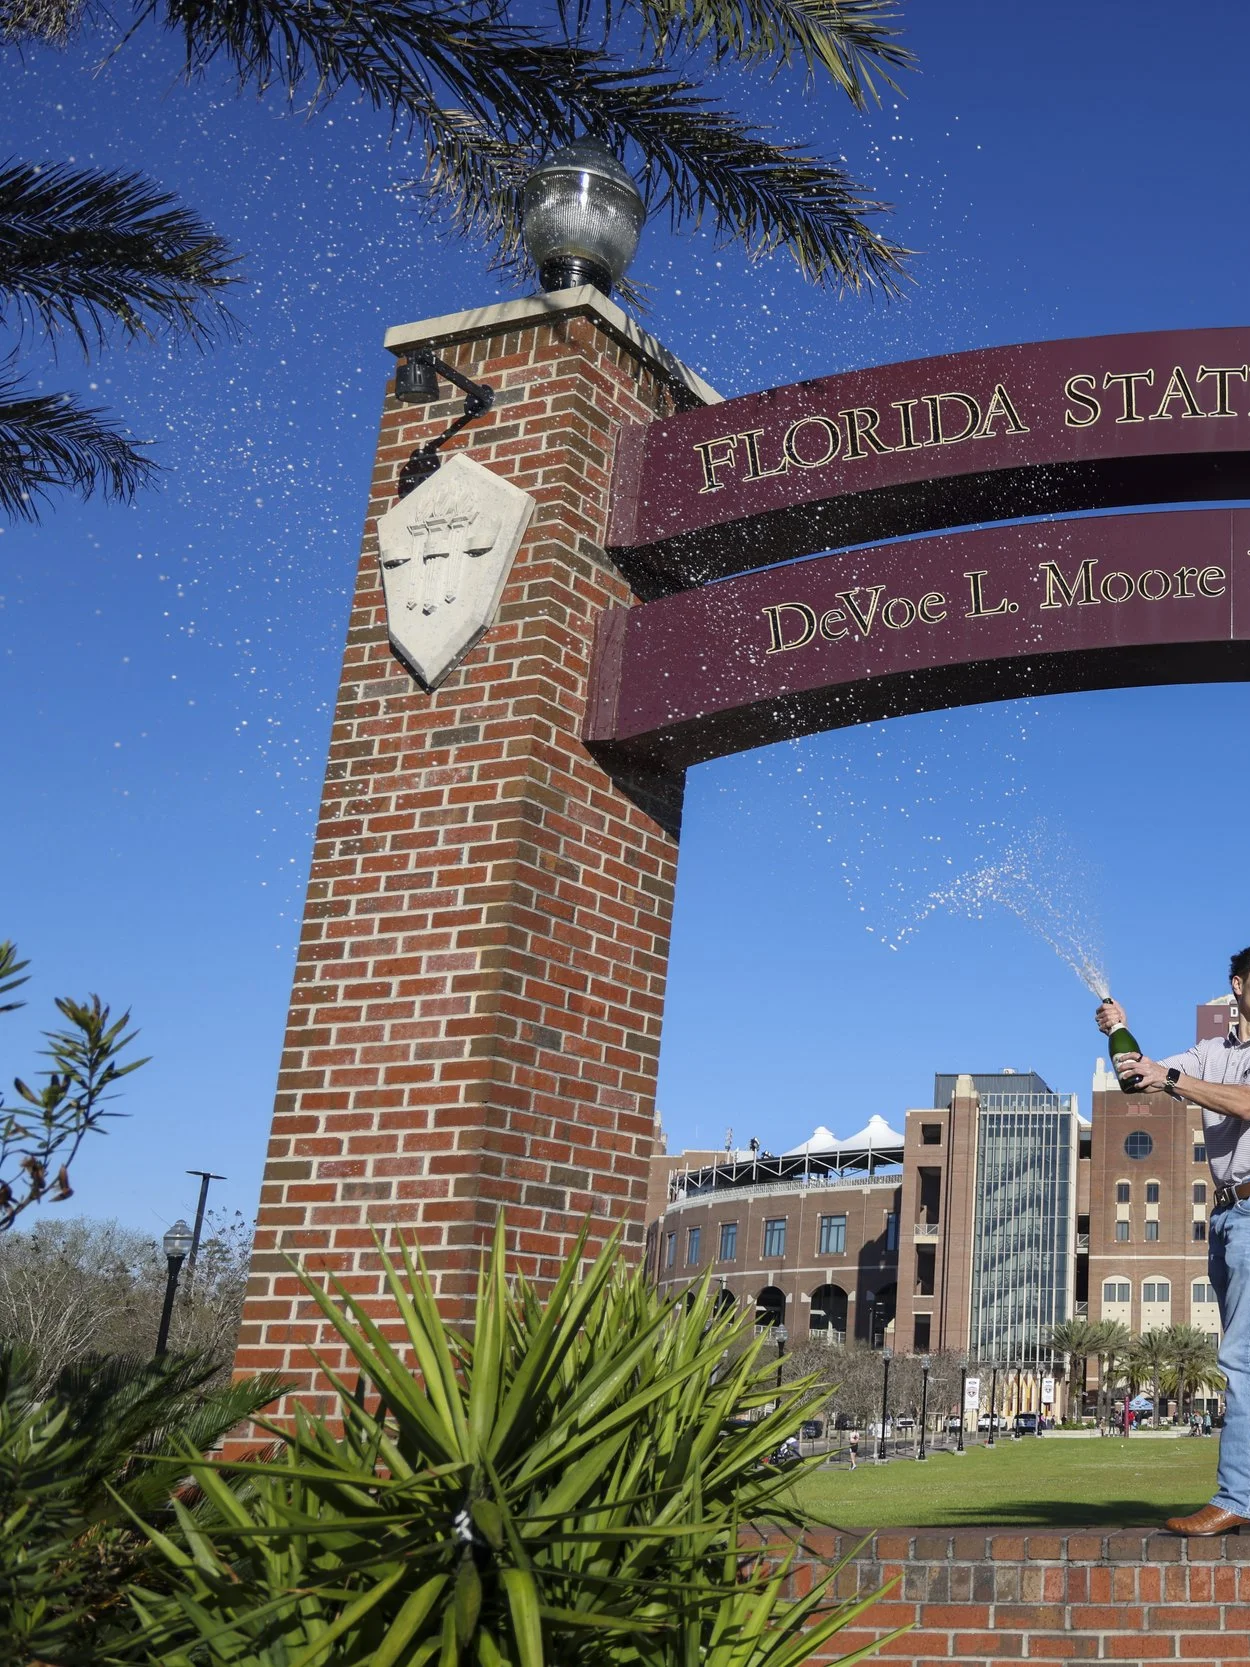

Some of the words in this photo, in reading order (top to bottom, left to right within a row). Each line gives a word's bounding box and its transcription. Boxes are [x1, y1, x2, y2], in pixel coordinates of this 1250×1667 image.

[694, 384, 1030, 494] FLORIDA
[762, 585, 947, 654] DeVoe
[964, 571, 1019, 618] L.
[1039, 559, 1226, 608] Moore
